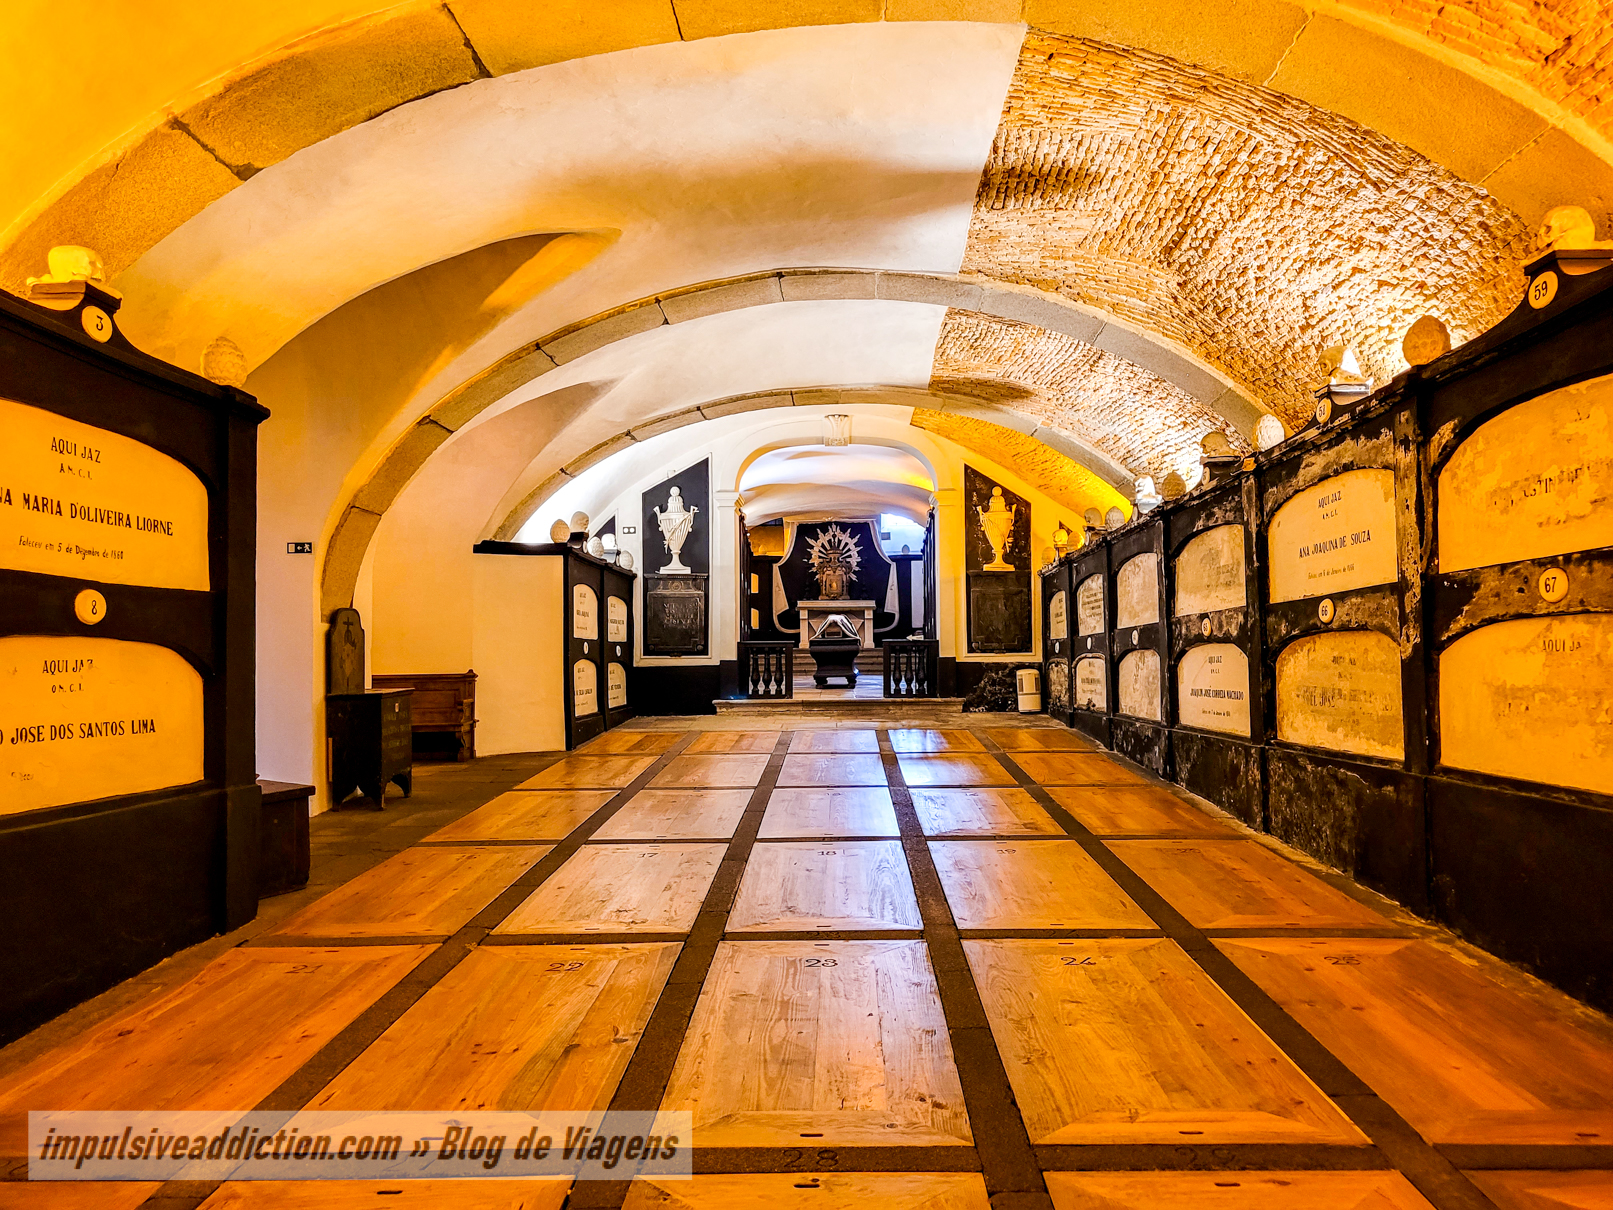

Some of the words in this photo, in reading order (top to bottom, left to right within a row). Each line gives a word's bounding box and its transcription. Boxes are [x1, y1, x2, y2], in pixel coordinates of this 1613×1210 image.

[1534, 280, 1548, 301] 59
[96, 315, 104, 331] 3
[50, 436, 77, 456] AQUI
[81, 446, 101, 463] JAZ
[1318, 494, 1330, 508] AQUI
[1330, 490, 1342, 505] JAZ
[23, 492, 63, 516] MARIA
[136, 516, 173, 536] LIORNE
[58, 542, 62, 552] 5
[65, 543, 72, 554] de
[102, 549, 109, 559] de
[1299, 545, 1310, 559] ANA
[1312, 538, 1338, 556] JOAQUINA
[1339, 536, 1347, 548] DE
[1351, 530, 1371, 546] SOUZA
[1545, 577, 1556, 593] 67
[91, 600, 97, 615] 8
[1321, 605, 1328, 616] 66
[42, 660, 68, 675] AQUI
[11, 725, 45, 745] JOSE
[50, 723, 74, 740] DOS
[79, 720, 125, 738] SANTOS
[131, 719, 156, 734] LIMA
[285, 964, 324, 974] 21
[545, 962, 585, 972] 22
[804, 958, 838, 968] 23
[1060, 957, 1097, 967] 24
[783, 1149, 839, 1168] 28
